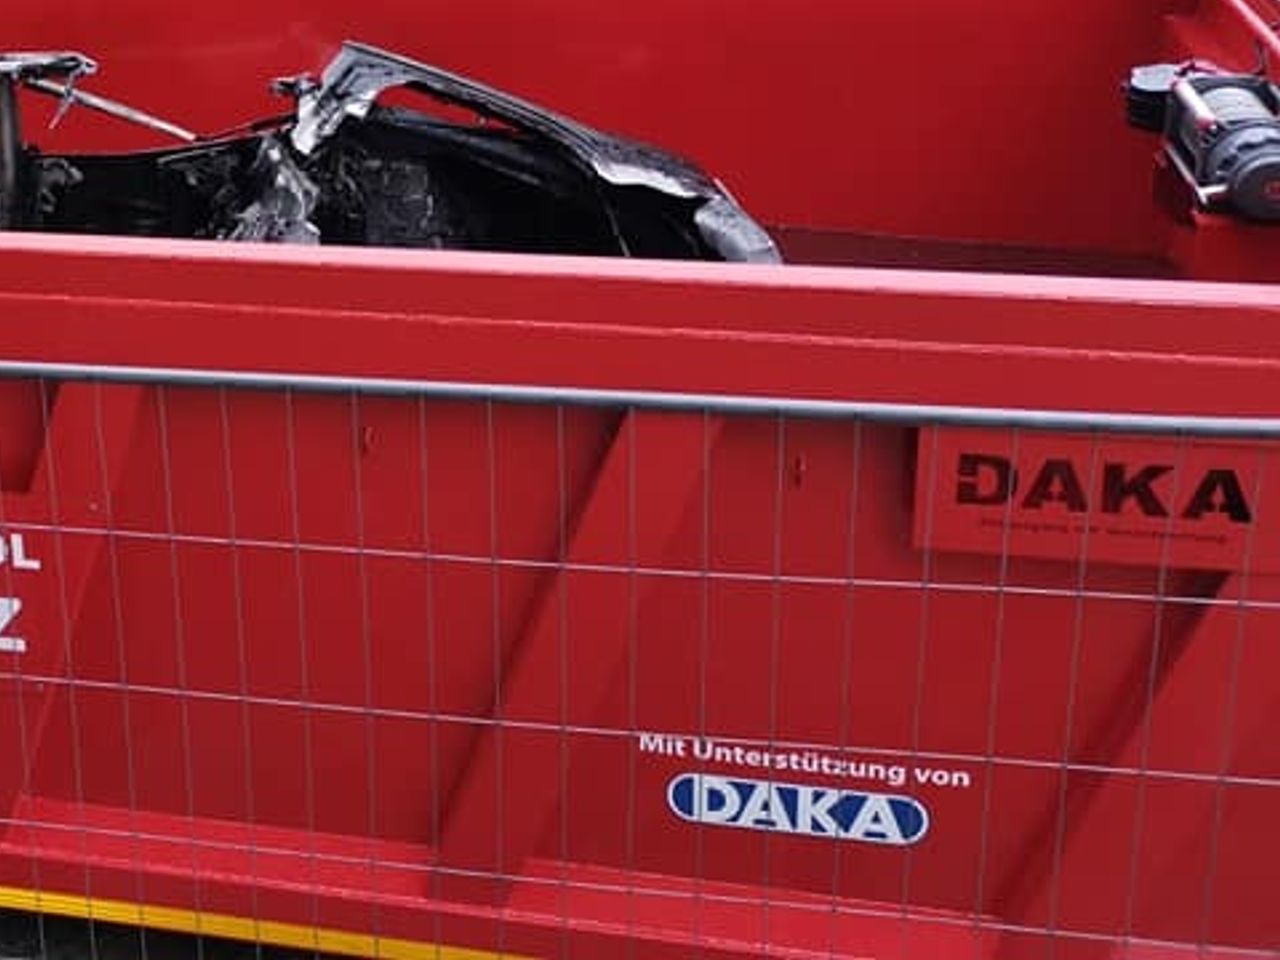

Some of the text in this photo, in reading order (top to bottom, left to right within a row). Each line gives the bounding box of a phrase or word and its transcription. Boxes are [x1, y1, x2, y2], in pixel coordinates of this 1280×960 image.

[956, 453, 1252, 523] DAKA
[639, 734, 971, 788] Mit Unterstützung von
[692, 774, 906, 842] DAKA
